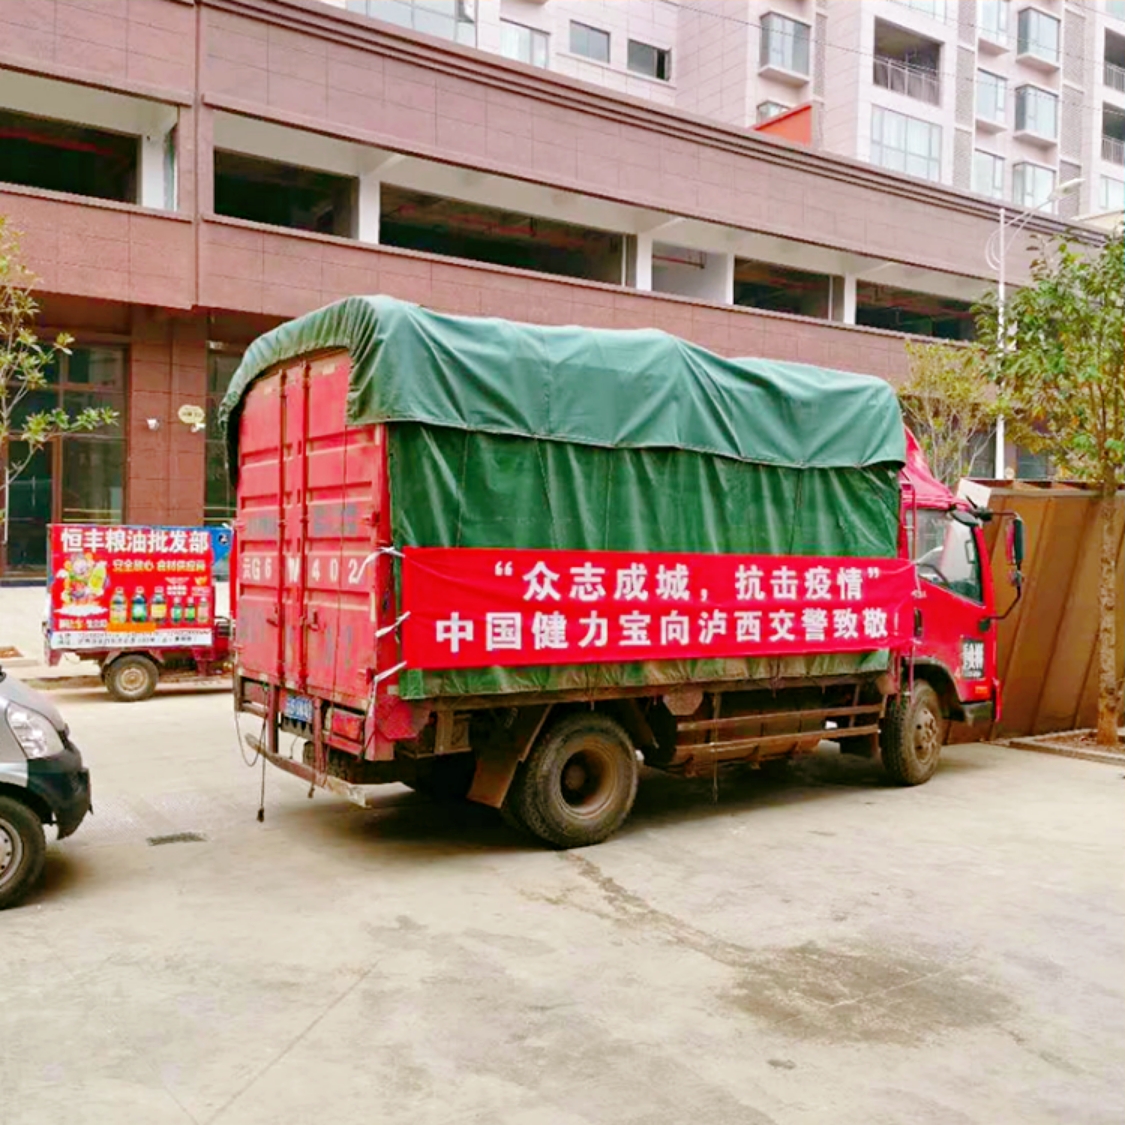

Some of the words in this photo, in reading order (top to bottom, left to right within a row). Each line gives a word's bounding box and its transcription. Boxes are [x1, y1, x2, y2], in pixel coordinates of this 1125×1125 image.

[60, 527, 210, 556] 恒丰粮油批发部
[494, 560, 881, 603] “众志成城，抗击疫情”
[434, 607, 899, 654] 中国健力宝向泸西交警致敬！
